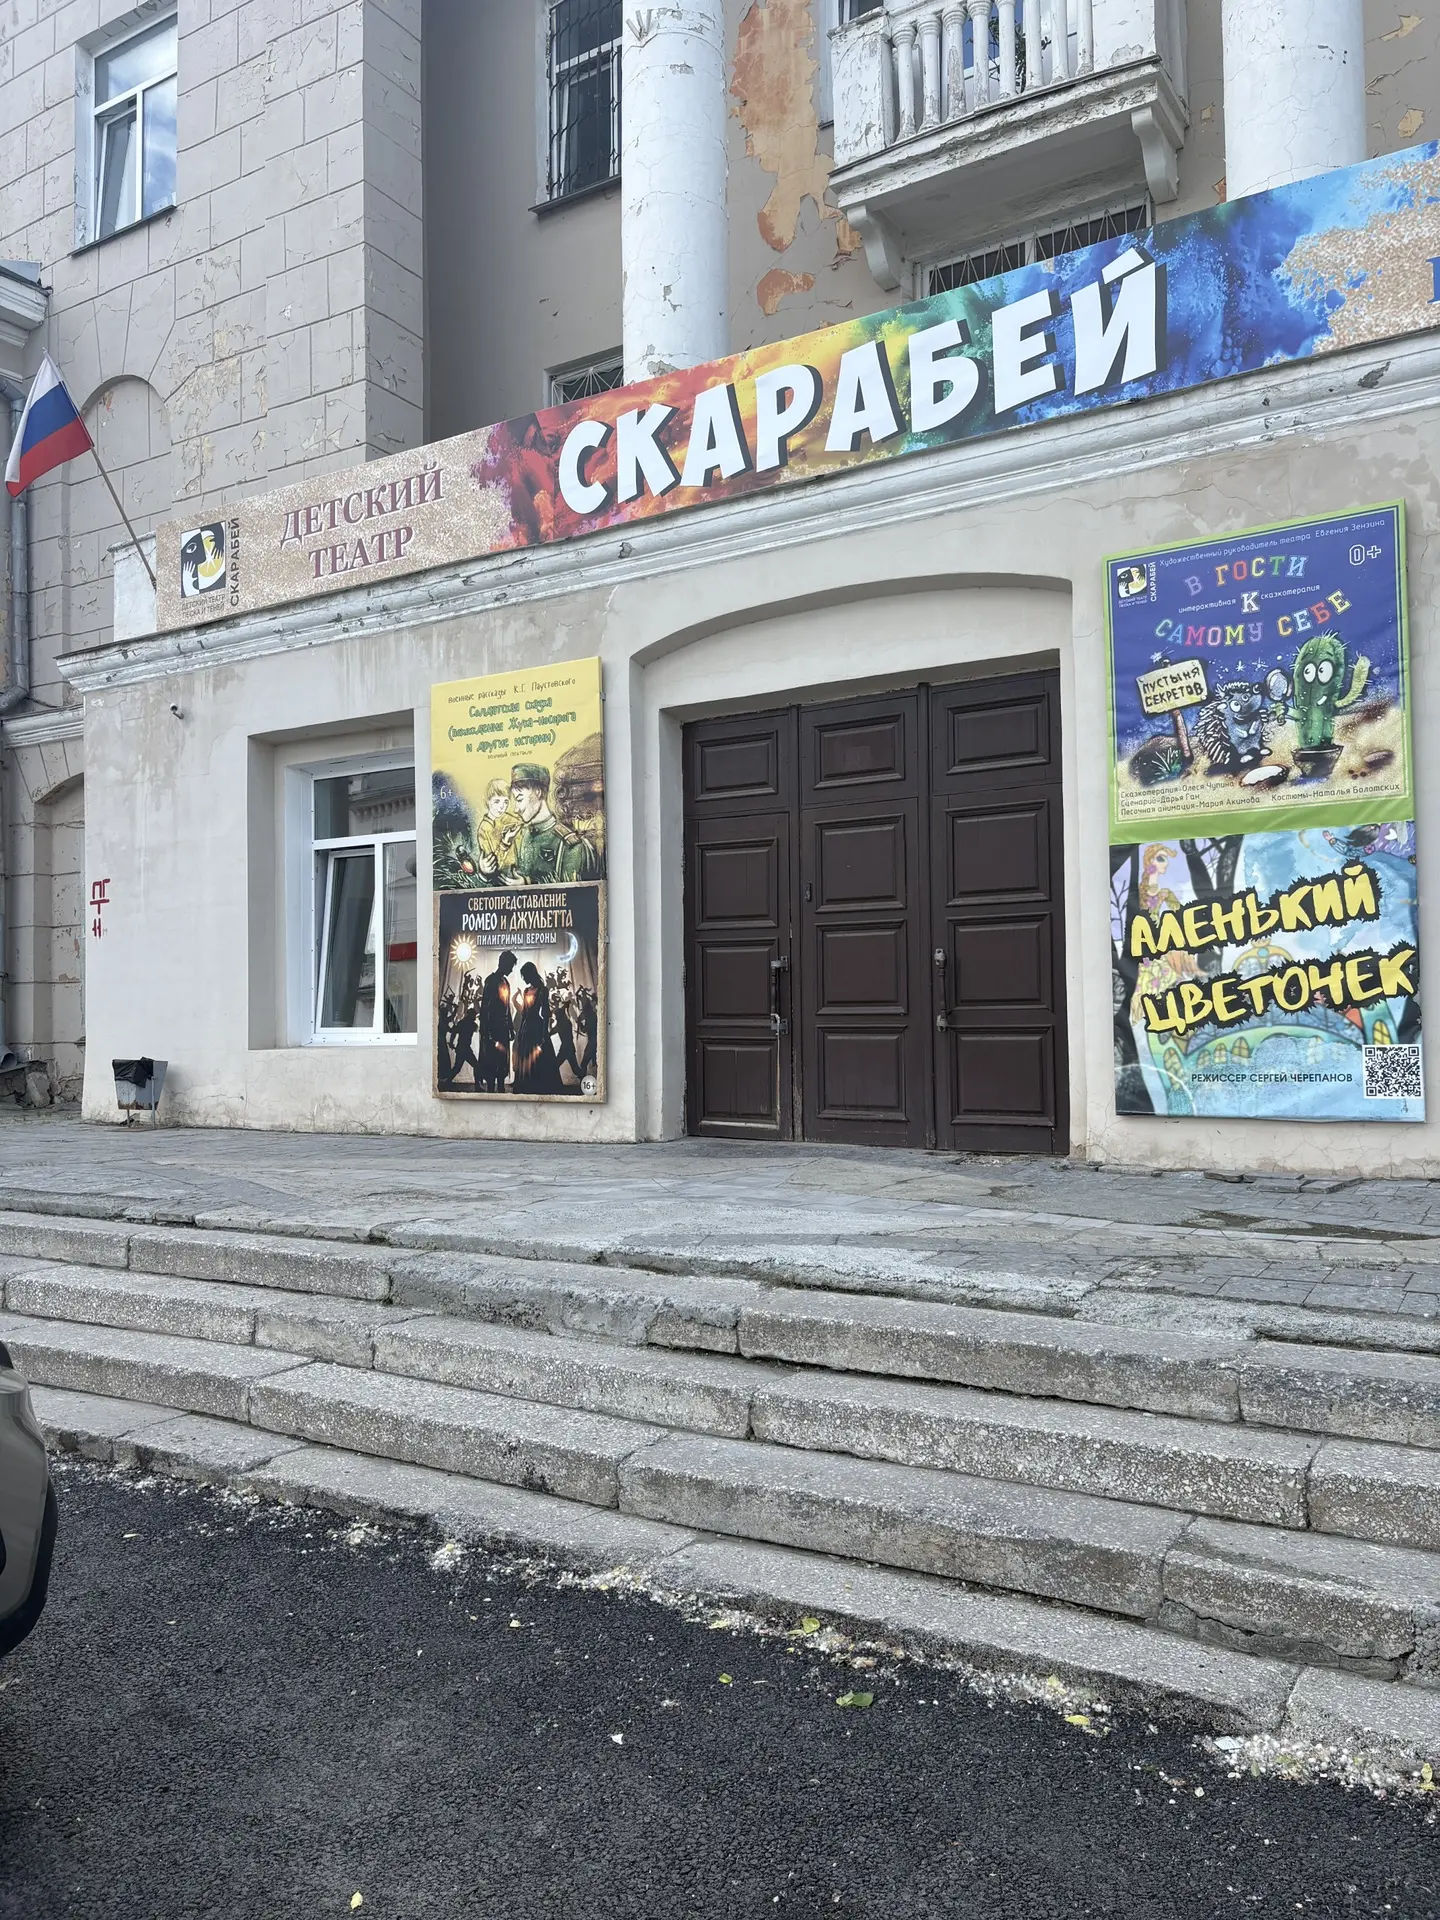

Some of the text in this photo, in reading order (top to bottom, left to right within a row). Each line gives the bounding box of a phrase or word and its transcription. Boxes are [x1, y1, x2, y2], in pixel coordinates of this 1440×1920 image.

[558, 248, 1166, 514] СКАРАБЕЙ
[280, 461, 445, 550] ДЕТСКИЙ
[308, 526, 414, 579] ТЕАТР
[1159, 520, 1385, 567] Художественный руководитель театра Евгения Зензина
[1349, 544, 1382, 566] 0+
[228, 517, 240, 607] СКАРАБЕЙ
[1184, 554, 1309, 596] В ГОСТИ
[1148, 561, 1157, 602] СКАРАБЕЙ
[1178, 584, 1321, 614] интерактивная сказкотерапия
[1241, 591, 1260, 614] К
[1155, 589, 1351, 646] САМОМУ СЕБЕ
[1142, 666, 1201, 695] ПУСТЫНЯ
[1144, 681, 1204, 707] СЕКРЕТОВ
[1206, 780, 1235, 791] Чупина
[1352, 783, 1400, 794] Болотских
[1121, 806, 1155, 816] Песочная
[1226, 796, 1260, 806] Акимова
[468, 892, 567, 911] СВЕТОПРЕДСТАВЛЕНИЕ
[1131, 864, 1376, 957] АЛЕНЬКИЙ
[462, 912, 498, 931] РОМЕО
[509, 909, 573, 932] ДЖУЛЬЕТТА
[476, 932, 557, 946] ПИЛИГРИМЫ ВЕРОНЫ
[1144, 949, 1416, 1034] ЦВЕТОЧЕК
[583, 1081, 596, 1090] 16+
[1190, 1071, 1354, 1083] РЕЖИССЕР СЕРГЕЙ ЧЕРЕПАНОВ
